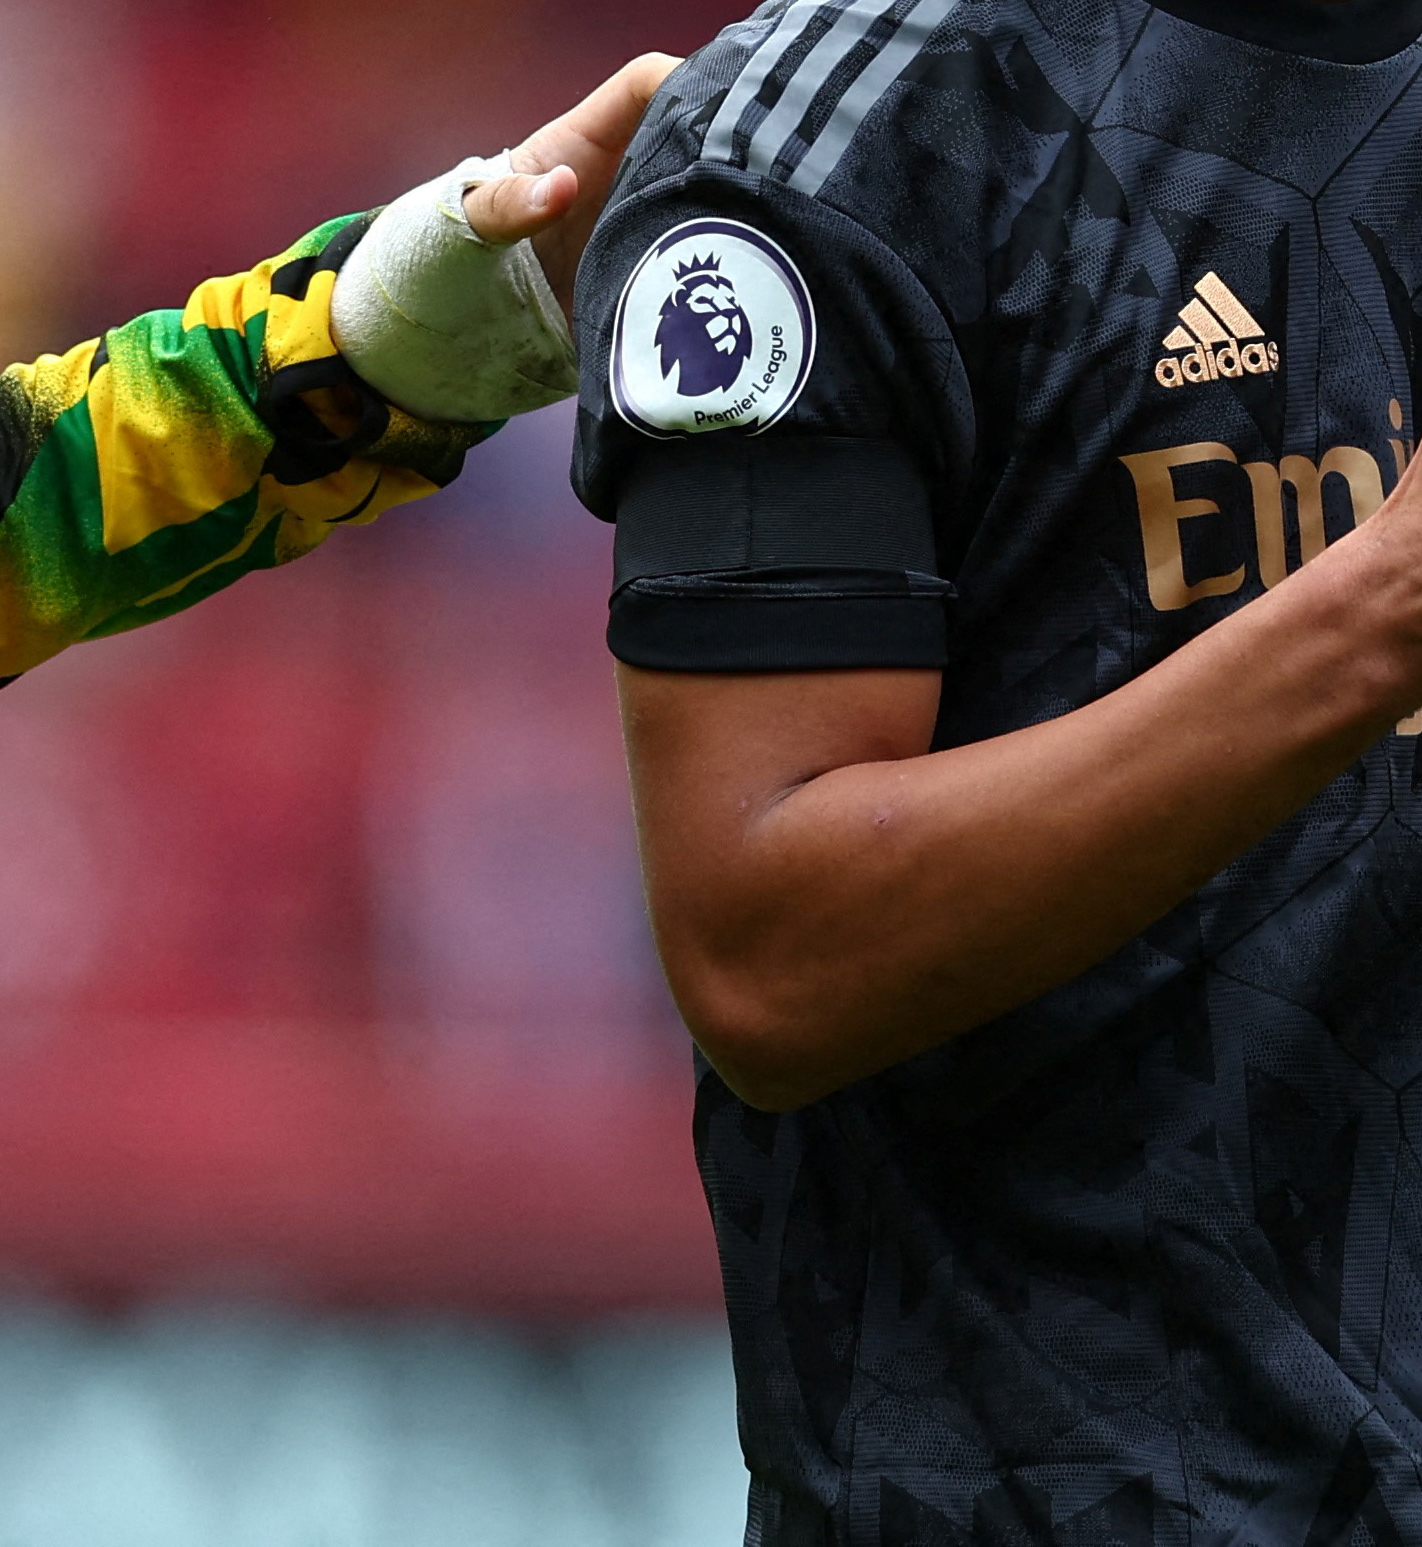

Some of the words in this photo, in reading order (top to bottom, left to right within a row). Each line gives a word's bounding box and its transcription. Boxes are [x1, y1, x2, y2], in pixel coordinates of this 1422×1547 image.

[694, 391, 758, 426] Premier
[752, 324, 788, 394] League
[1155, 337, 1280, 388] adidas
